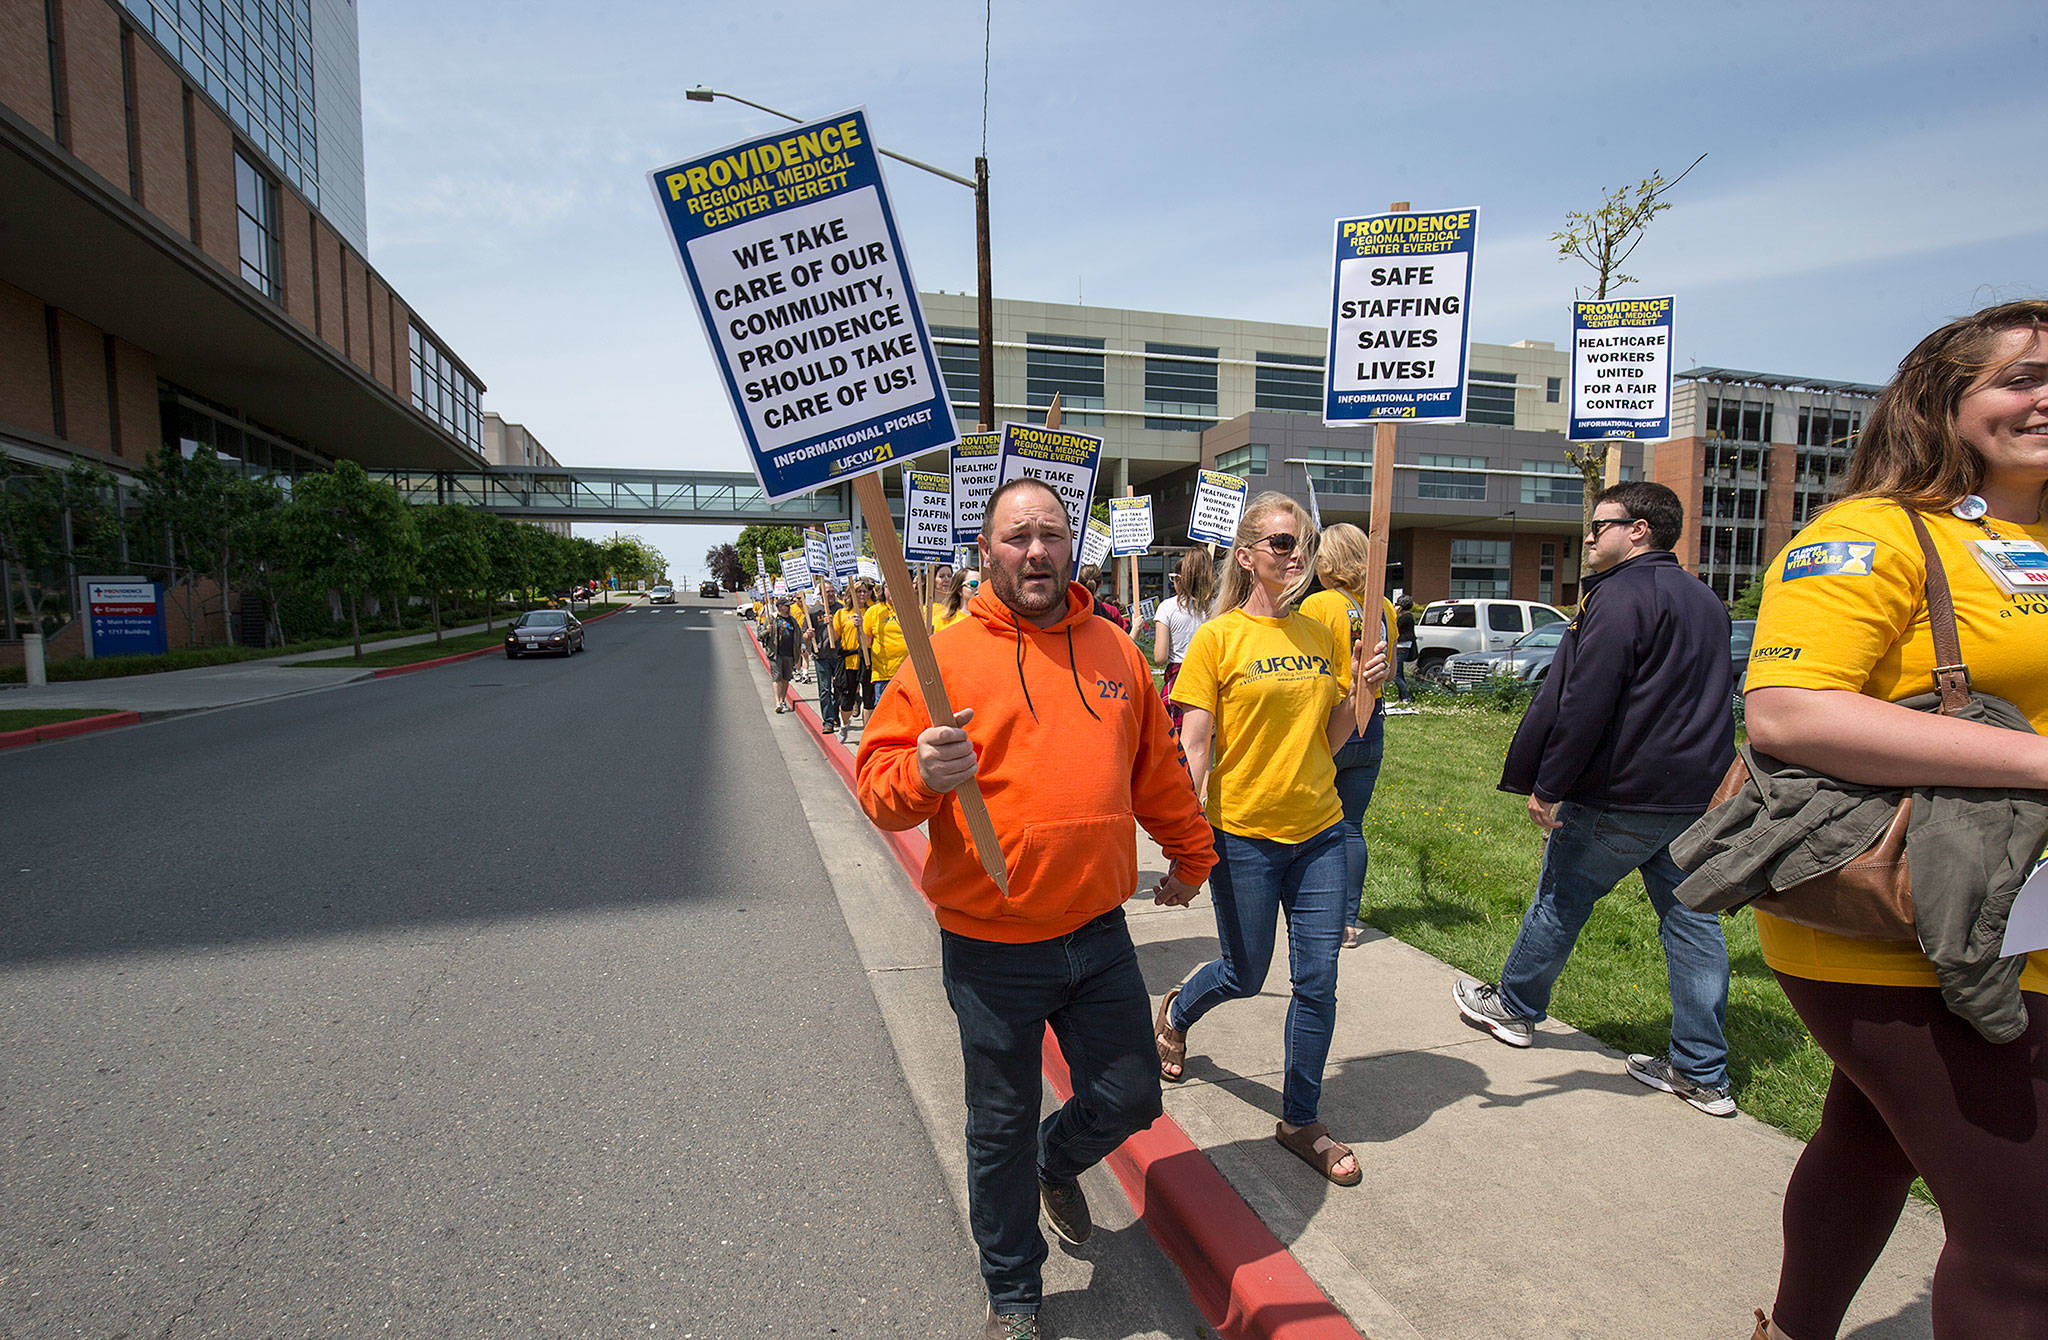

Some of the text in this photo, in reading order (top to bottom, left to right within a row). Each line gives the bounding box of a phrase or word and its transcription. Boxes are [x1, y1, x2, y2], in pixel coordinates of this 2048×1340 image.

[665, 119, 862, 201] PROVIDENCE
[686, 152, 855, 214] REGIONAL MEDICAL
[703, 172, 848, 228] CENTER EVERETT
[1343, 213, 1471, 238] PROVIDENCE
[732, 217, 848, 271] WE TAKE
[1350, 230, 1460, 247] REGIONAL MEDICAL
[1356, 241, 1454, 256] CENTER EVERETT
[714, 241, 888, 311] CARE OF OUR
[1370, 266, 1434, 287] SAFE
[729, 275, 893, 341] COMMUNITY,
[1341, 296, 1460, 319] STAFFING
[1577, 299, 1670, 314] PROVIDENCE
[1582, 310, 1663, 321] REGIONAL MEDICAL
[1587, 318, 1657, 328] CENTER EVERETT
[738, 304, 904, 372] PROVIDENCE
[1358, 329, 1438, 350] SAVES
[1579, 335, 1665, 348] HEALTHCARE
[1587, 352, 1655, 363] WORKERS
[744, 333, 916, 403] SHOULD TAKE
[1357, 360, 1435, 380] LIVES!
[1597, 368, 1644, 378] UNITED
[1584, 384, 1657, 394] FOR A FAIR
[763, 365, 917, 429] CARE OF US!
[1338, 392, 1451, 404] INFORMATIONAL PICKET
[1586, 400, 1654, 410] CONTRACT
[773, 426, 883, 468] INFORMATIONAL
[884, 408, 932, 437] PICKET
[960, 435, 1000, 445] ROVIDEN
[1010, 427, 1098, 452] PROVIDENCE
[1014, 439, 1090, 458] REGIONAL MEDICAL
[1017, 448, 1085, 464] CENTER EVERETT
[912, 473, 949, 484] PROVIDEN
[961, 475, 996, 485] WORKE
[1023, 466, 1074, 483] WE TAKE
[968, 488, 993, 496] UNITE
[1060, 486, 1085, 500] OUR
[1200, 487, 1240, 502] HEALTHCARE
[923, 496, 947, 506] SAFE
[960, 501, 978, 509] FOR
[1203, 496, 1236, 508] WORKERS
[1198, 511, 1212, 519] FOR
[1220, 516, 1234, 524] FAIR
[1206, 505, 1229, 515] UNITED
[918, 522, 948, 533] SAVES
[1198, 520, 1232, 532] CONTRACT
[917, 536, 947, 546] LIVES!
[1812, 549, 1828, 558] FOR
[1787, 555, 1843, 570] VITAL CARE
[105, 606, 144, 614] Emergency
[2000, 609, 2012, 618] a
[1096, 680, 1128, 700] 292
